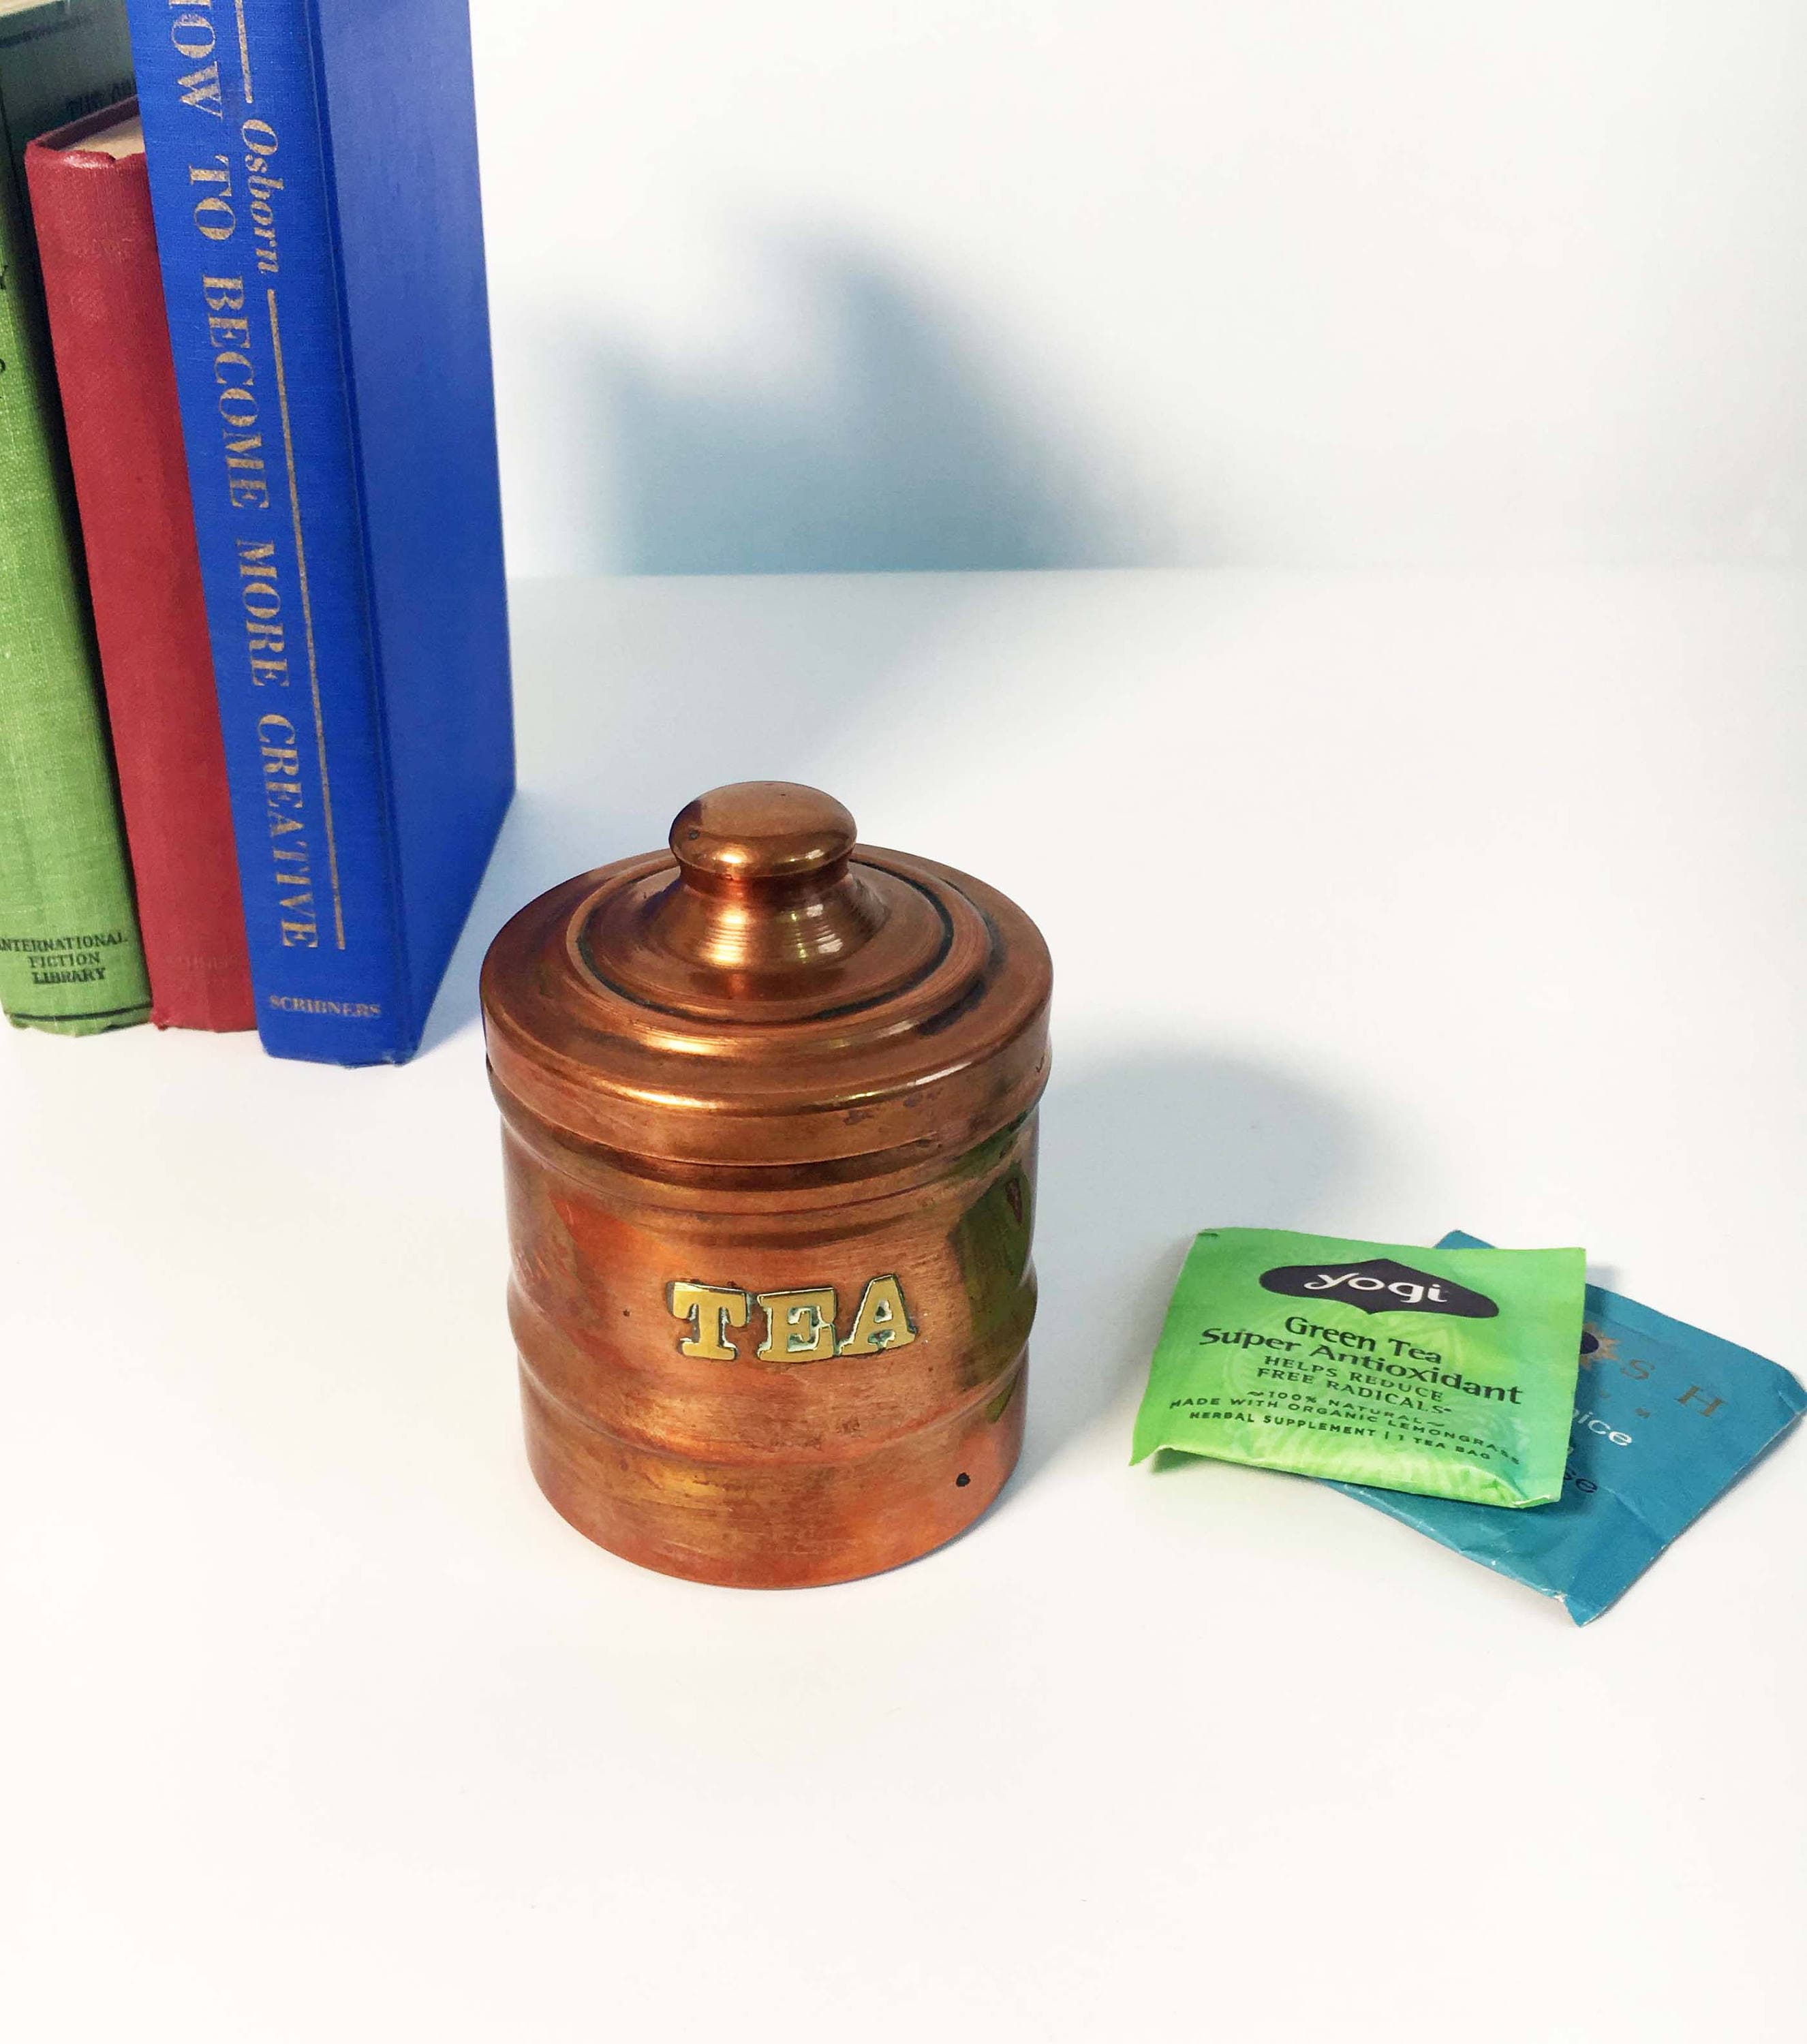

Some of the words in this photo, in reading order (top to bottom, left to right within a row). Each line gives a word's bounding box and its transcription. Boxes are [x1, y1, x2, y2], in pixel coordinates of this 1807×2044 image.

[187, 154, 236, 242] TO
[241, 119, 285, 275] Osborn
[202, 274, 270, 509] BECOME
[236, 538, 290, 687] MORE
[257, 714, 319, 949] CREATIVE
[0, 932, 128, 952] NTERNATIONAL
[27, 951, 101, 968] FICTION
[32, 967, 106, 984] LIBRARY
[270, 995, 382, 1017] SCRIBNERS
[1303, 1272, 1448, 1304] yogi
[666, 1273, 917, 1363] TEA
[1284, 1316, 1376, 1352] Green
[1388, 1337, 1442, 1364] Tea
[1199, 1328, 1302, 1352] Super
[1308, 1344, 1524, 1405] Antioxidant
[1256, 1367, 1316, 1384] FREE
[1264, 1355, 1338, 1378] HELPS
[1349, 1371, 1444, 1403] REDUCE
[1169, 1397, 1221, 1410] MADE
[1230, 1398, 1279, 1408] WITH
[1287, 1403, 1378, 1423] ORGANIC
[1387, 1419, 1520, 1465] LEMONGRASS
[1189, 1411, 1255, 1423] HERBAL
[1263, 1414, 1376, 1437] SUPPLEMENT
[1412, 1436, 1446, 1449] TEA
[1455, 1445, 1492, 1460] BAG
[1328, 1399, 1423, 1425] NATURAL
